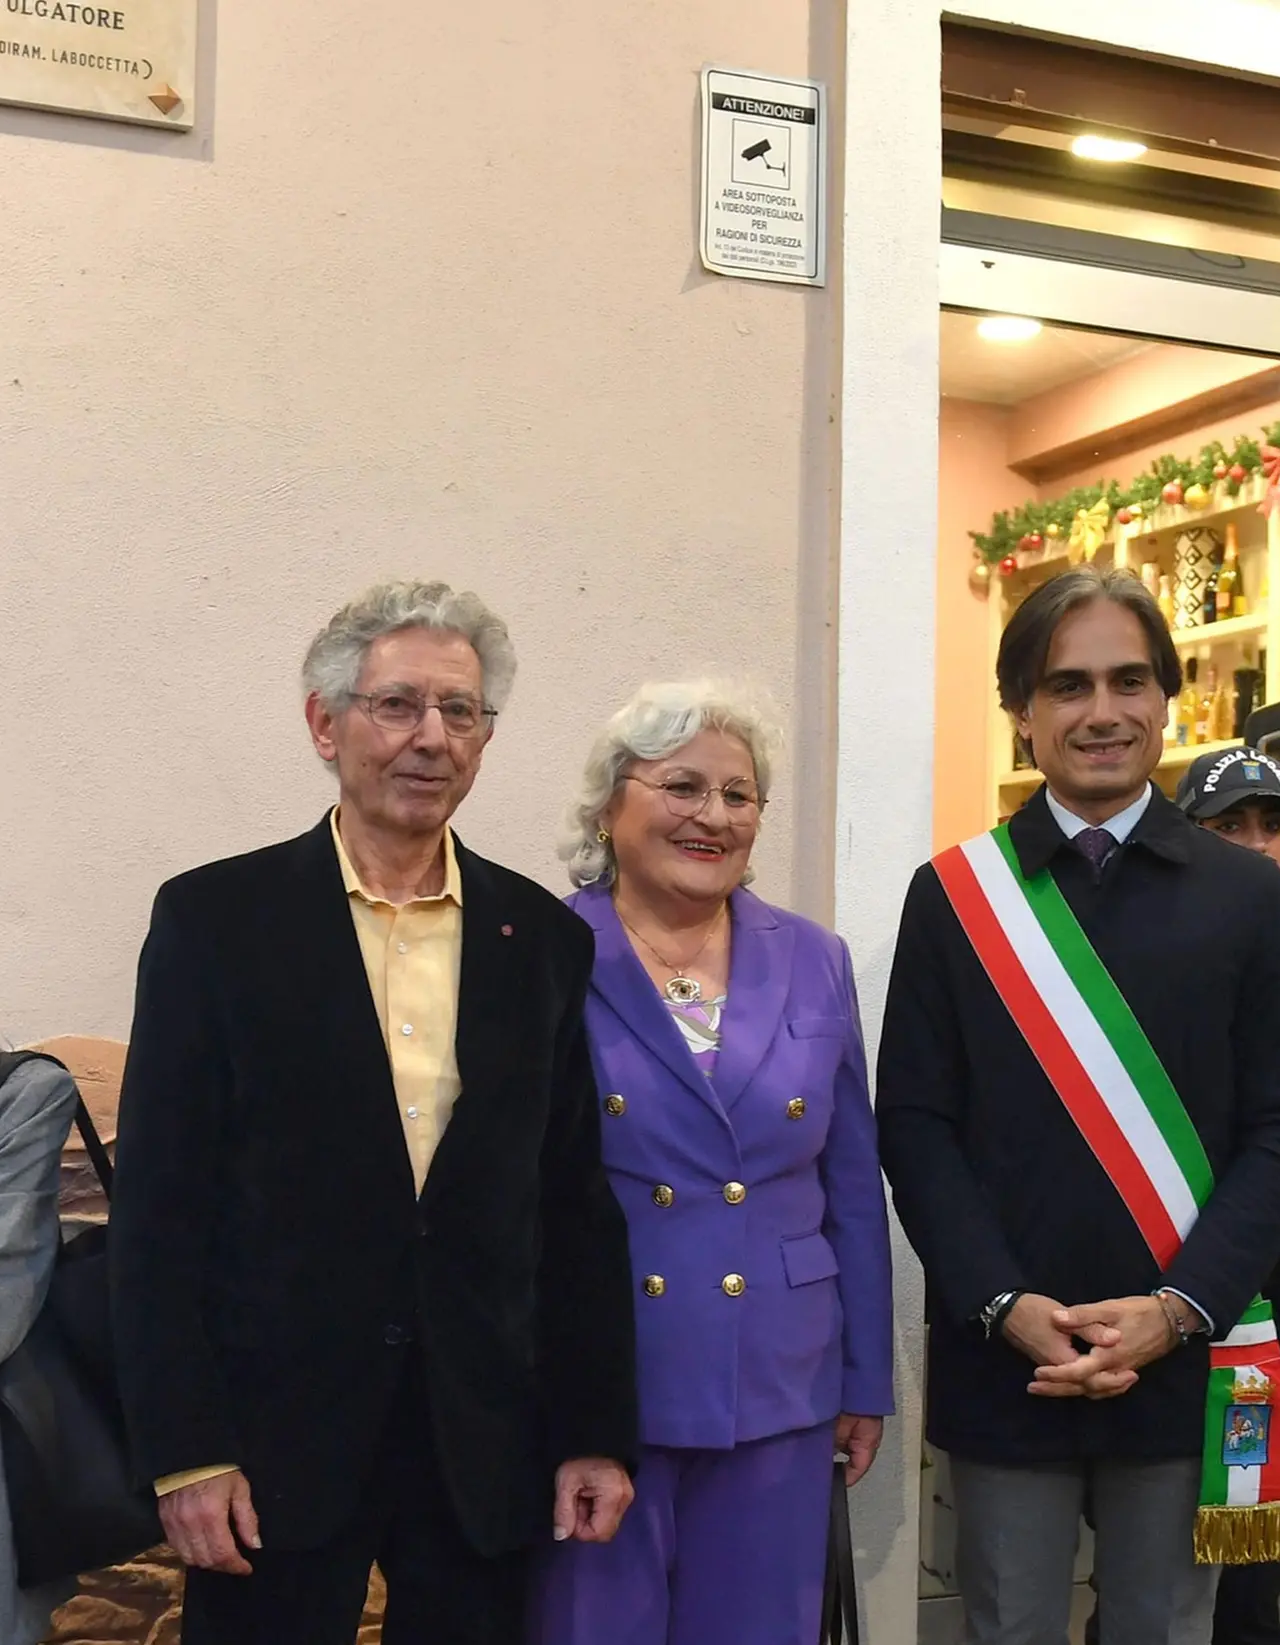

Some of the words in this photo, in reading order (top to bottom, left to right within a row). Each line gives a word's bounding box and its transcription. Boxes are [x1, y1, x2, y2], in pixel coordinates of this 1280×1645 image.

[51, 48, 153, 80] LABOCCETTA)
[722, 97, 805, 120] ATTENZIONE!
[722, 188, 744, 200] AREA
[745, 191, 797, 207] SOTTOPOSTA
[715, 201, 720, 210] A
[721, 202, 805, 222] VIDEOSORVEGLIANZA
[751, 219, 768, 230] PER
[716, 228, 748, 241] RAGIONI
[750, 232, 758, 242] DI
[759, 233, 802, 248] SICUREZZA
[1203, 750, 1248, 793] POLIZIA
